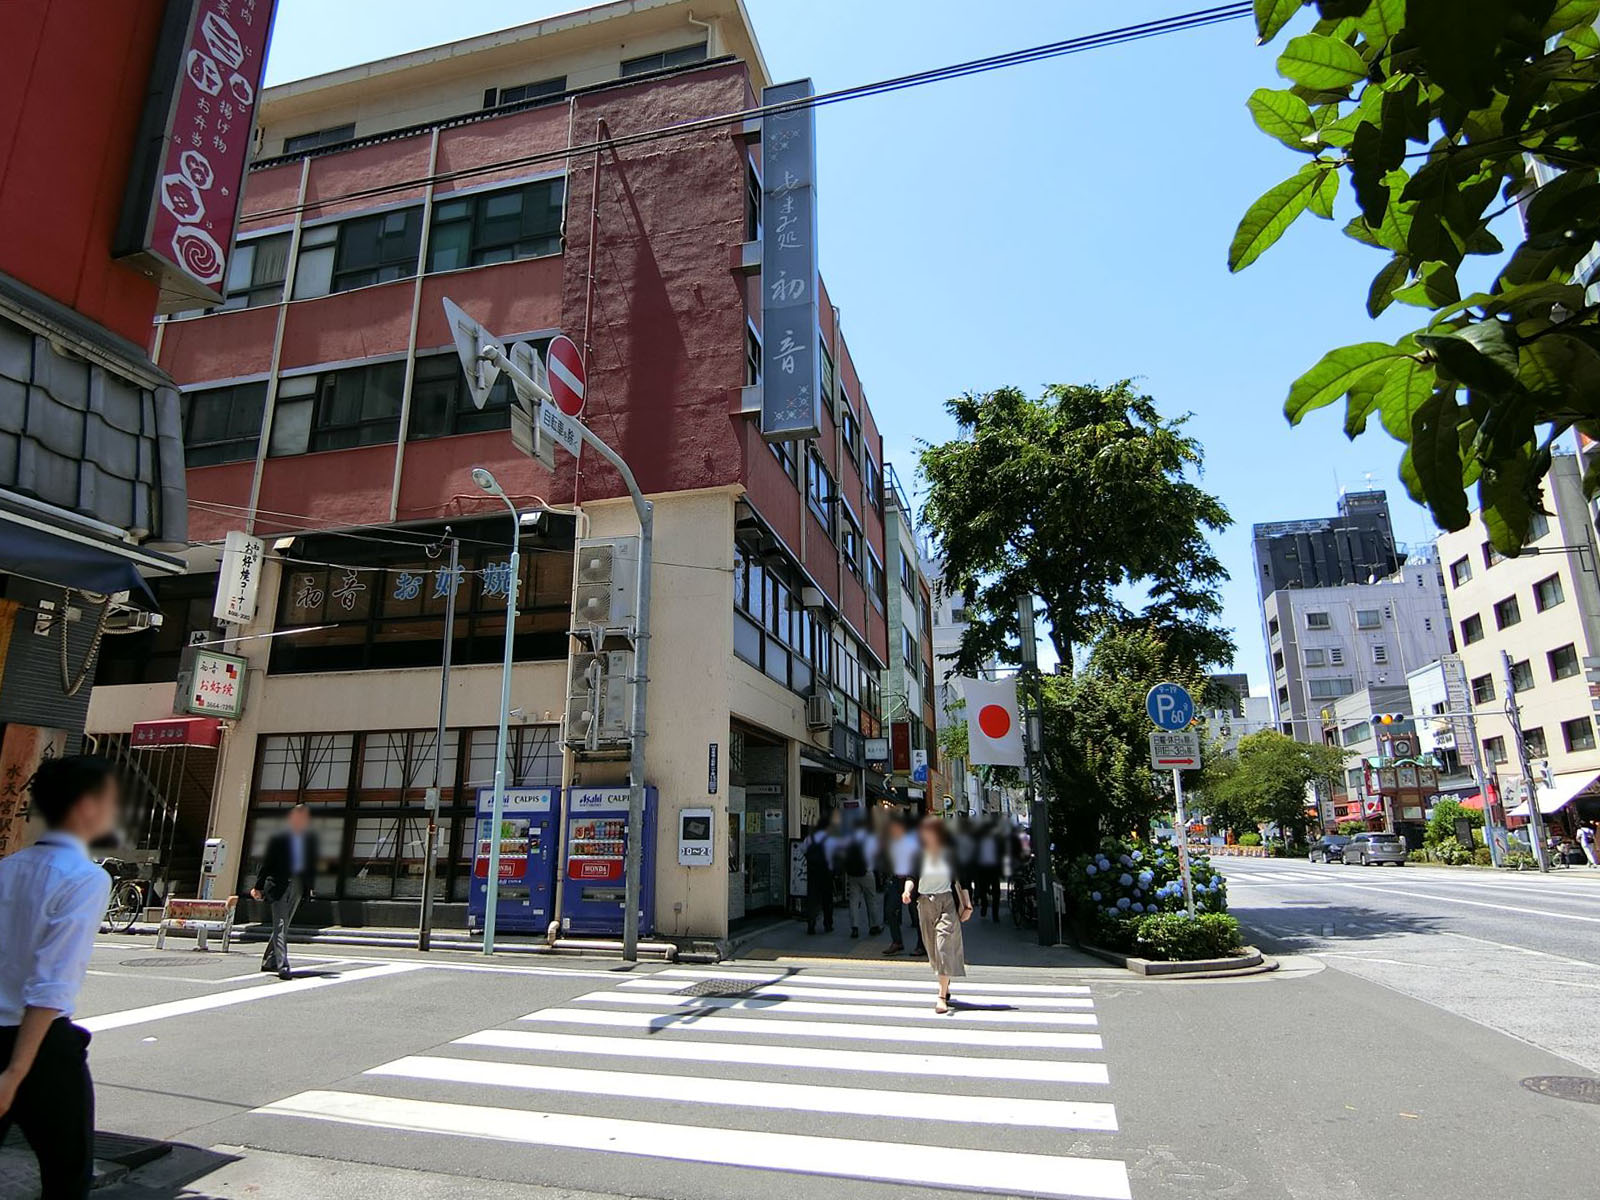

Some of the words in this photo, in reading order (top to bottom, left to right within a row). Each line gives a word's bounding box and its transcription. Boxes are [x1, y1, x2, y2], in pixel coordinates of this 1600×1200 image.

[191, 97, 211, 148] お弁当
[212, 99, 233, 154] 揚げ物
[771, 270, 806, 375] 初音
[543, 409, 579, 451] 自転車を除く
[237, 541, 253, 611] お好焼コーナー
[296, 569, 366, 611] 初音
[199, 661, 219, 675] 初音
[200, 680, 234, 697] お好焼
[1156, 694, 1176, 724] P
[514, 795, 540, 804] CALPIS
[579, 793, 603, 804] Asahi
[607, 794, 631, 804] CALPI
